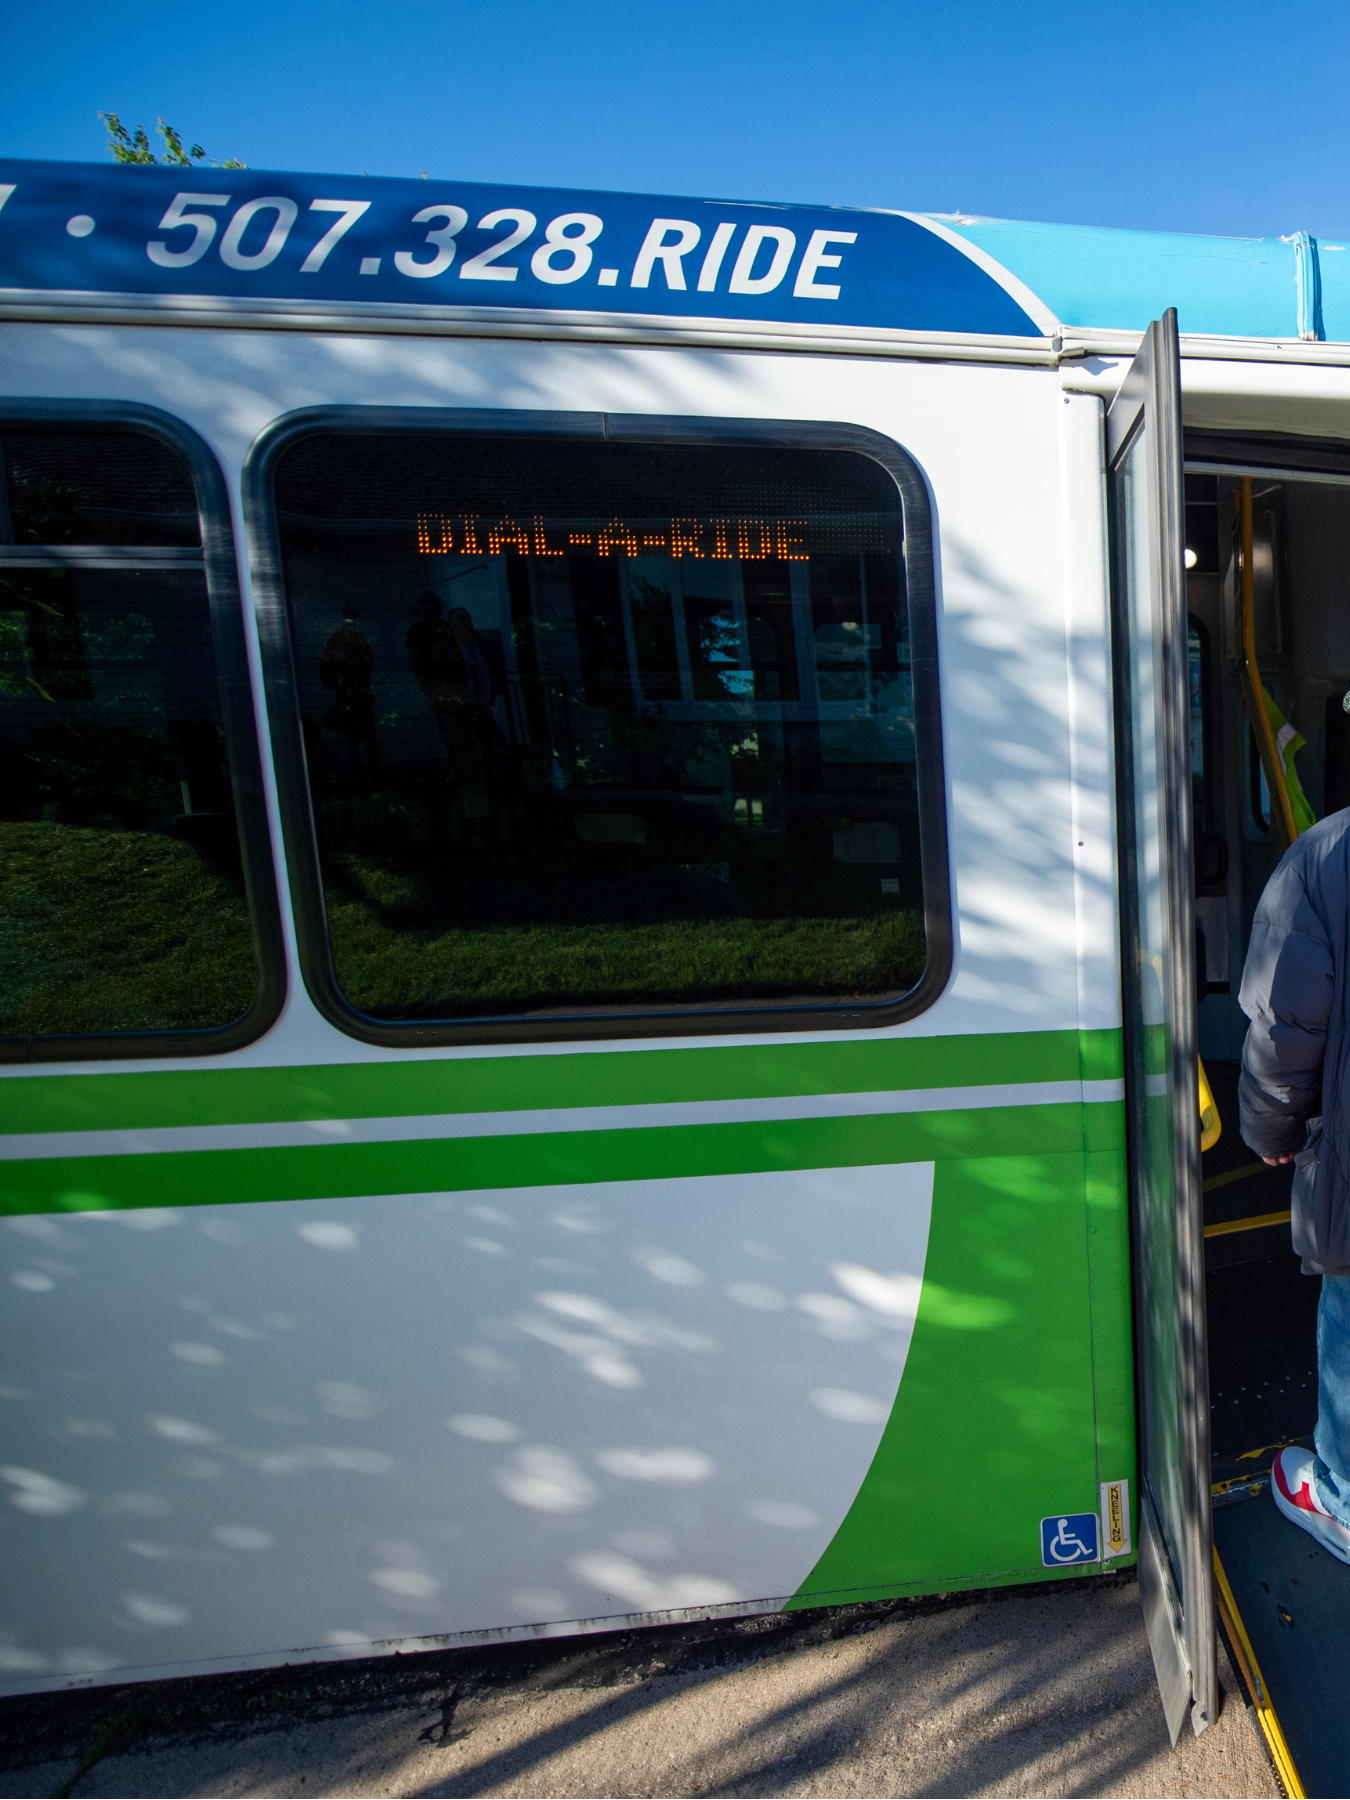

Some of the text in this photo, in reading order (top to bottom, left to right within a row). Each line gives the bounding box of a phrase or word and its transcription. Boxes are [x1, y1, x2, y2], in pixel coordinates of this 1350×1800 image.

[146, 192, 858, 300] 507.328.RIDE
[417, 513, 811, 560] DIAL-A-RIDE
[1110, 1486, 1122, 1543] KNEELING
